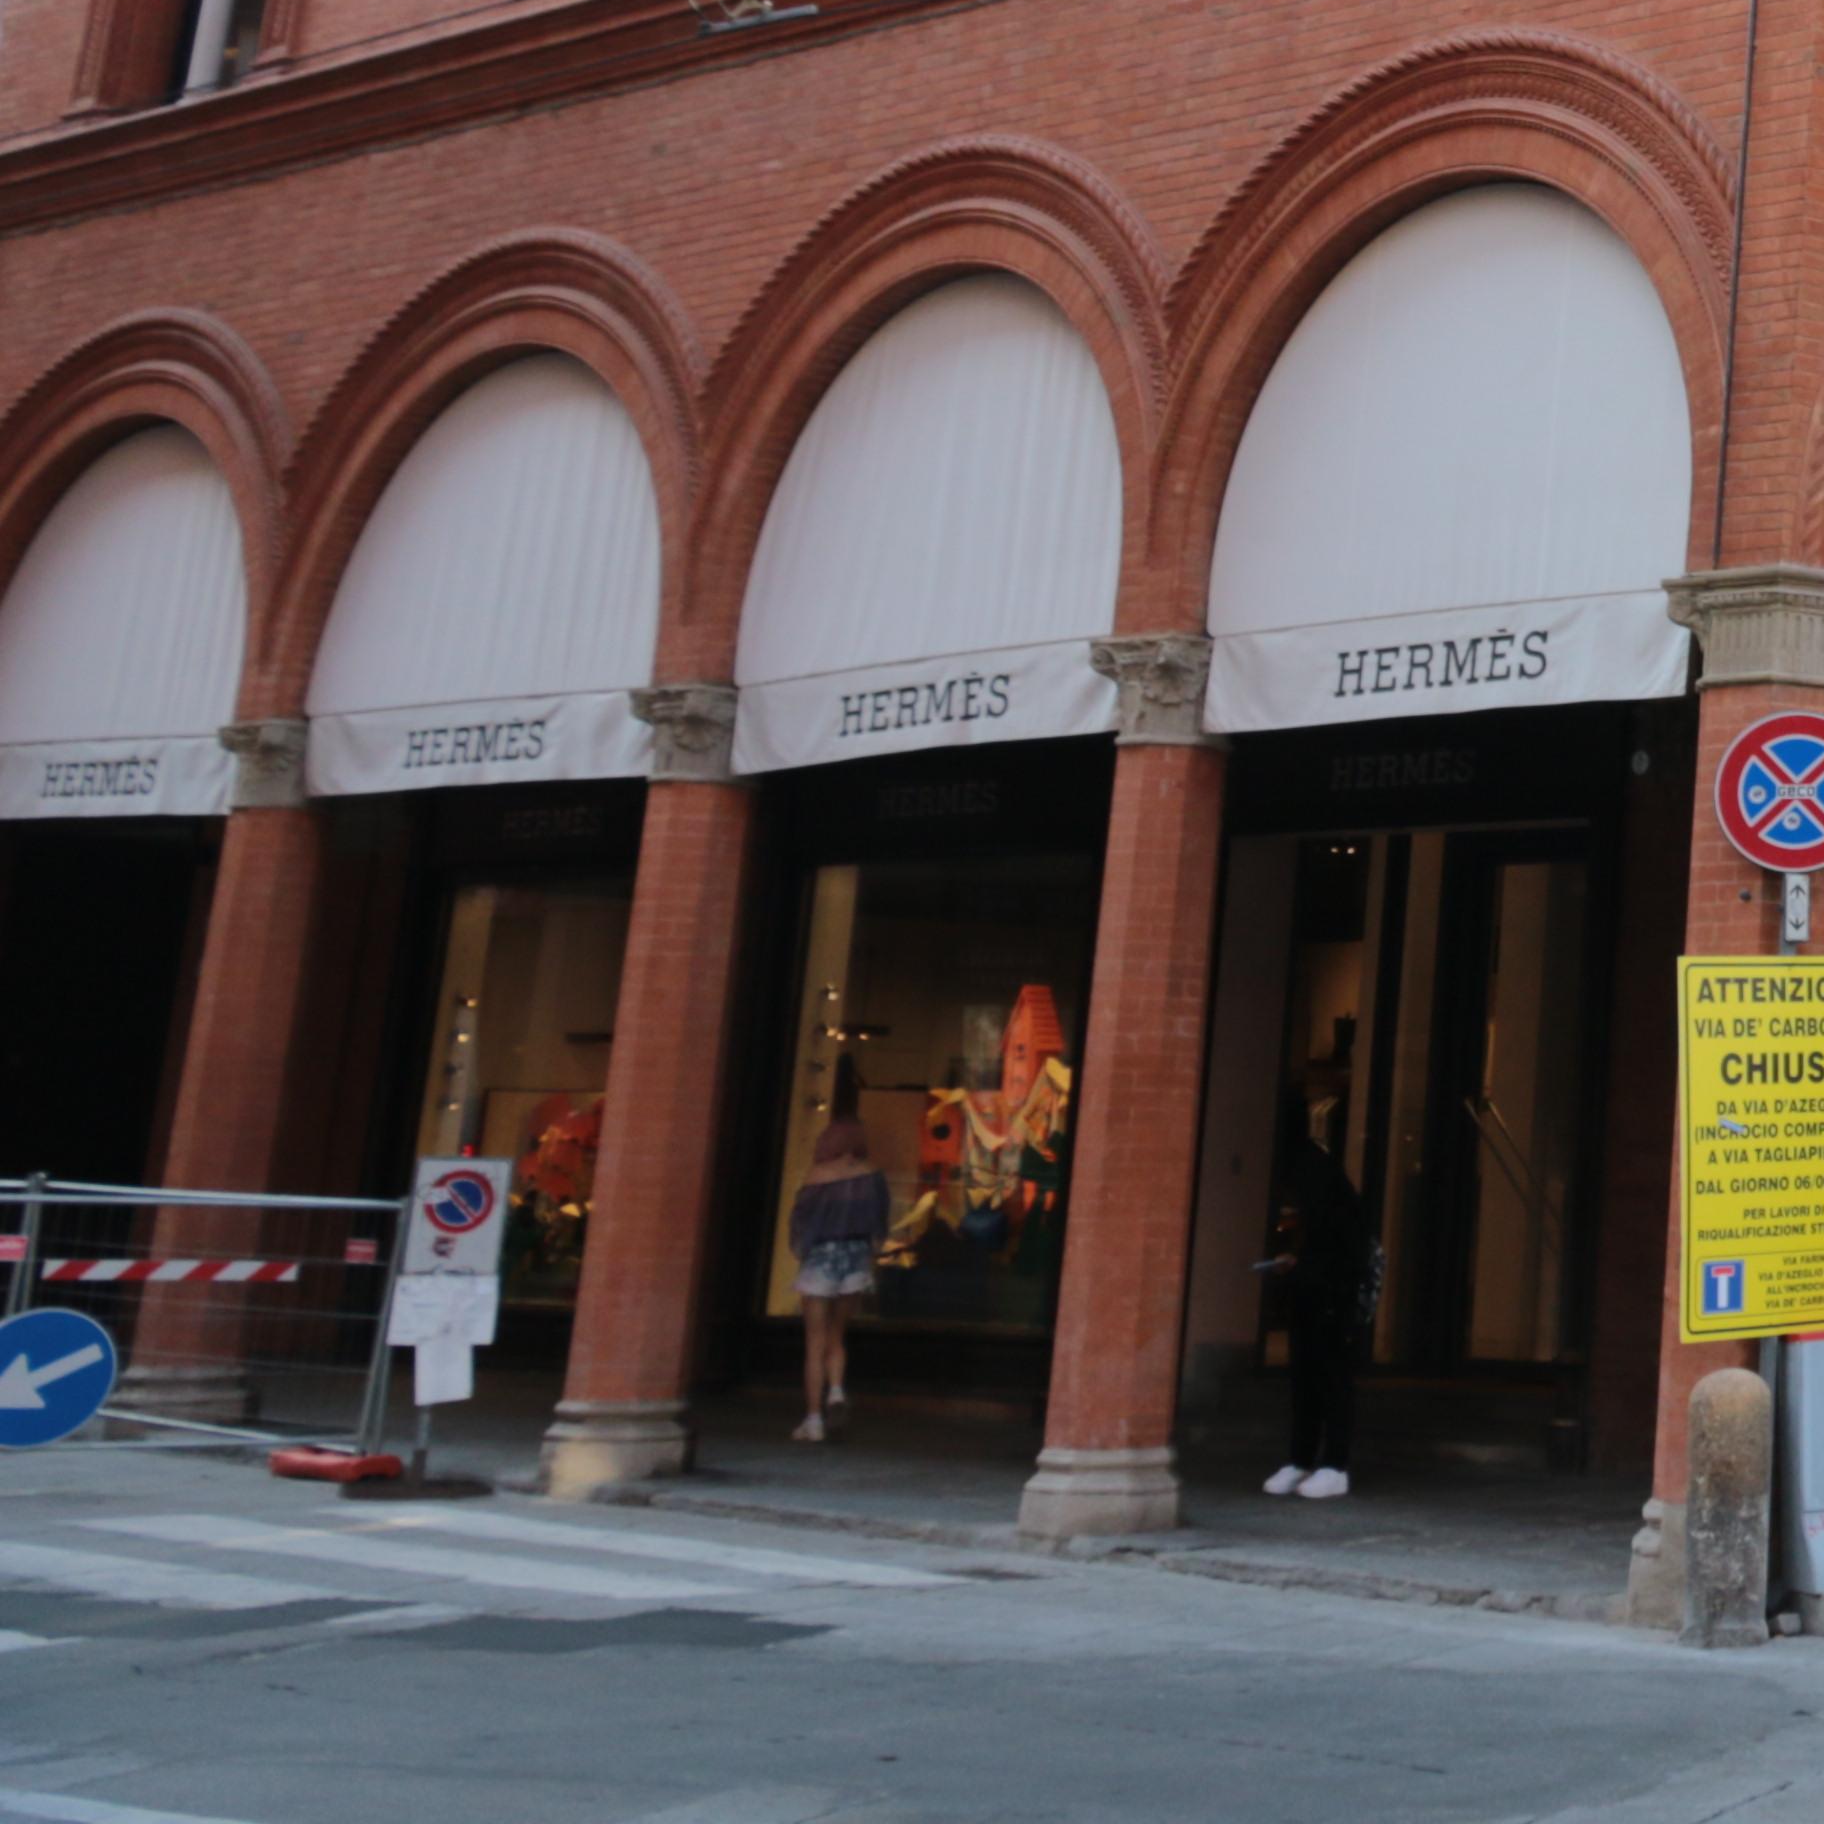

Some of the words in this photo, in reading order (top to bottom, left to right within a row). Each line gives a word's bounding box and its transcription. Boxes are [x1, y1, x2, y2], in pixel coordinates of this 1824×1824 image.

[1333, 629, 1549, 696] HERMÈS
[838, 672, 1011, 737] HERMÈS
[402, 718, 547, 769] HERMÈS
[41, 757, 159, 798] HERMÈS
[1695, 1018, 1726, 1038] VIA
[1734, 1018, 1762, 1037] DE'
[1717, 1101, 1737, 1115] DA
[1744, 1100, 1768, 1114] VIA
[1708, 1150, 1718, 1164] A
[1723, 1149, 1749, 1164] VIA
[1696, 1180, 1724, 1195] DAL
[1731, 1177, 1789, 1193] GIORNO
[1743, 1208, 1766, 1220] PER
[1771, 1205, 1810, 1218] LAVORI
[1815, 1204, 1824, 1216] DI
[1698, 1224, 1806, 1241] RIQUALIFICAZIONE
[1783, 1256, 1797, 1265] VIA
[1758, 1272, 1773, 1281] VIA
[1776, 1268, 1824, 1281] D'AZEGLIO
[1765, 1299, 1780, 1308] VIA
